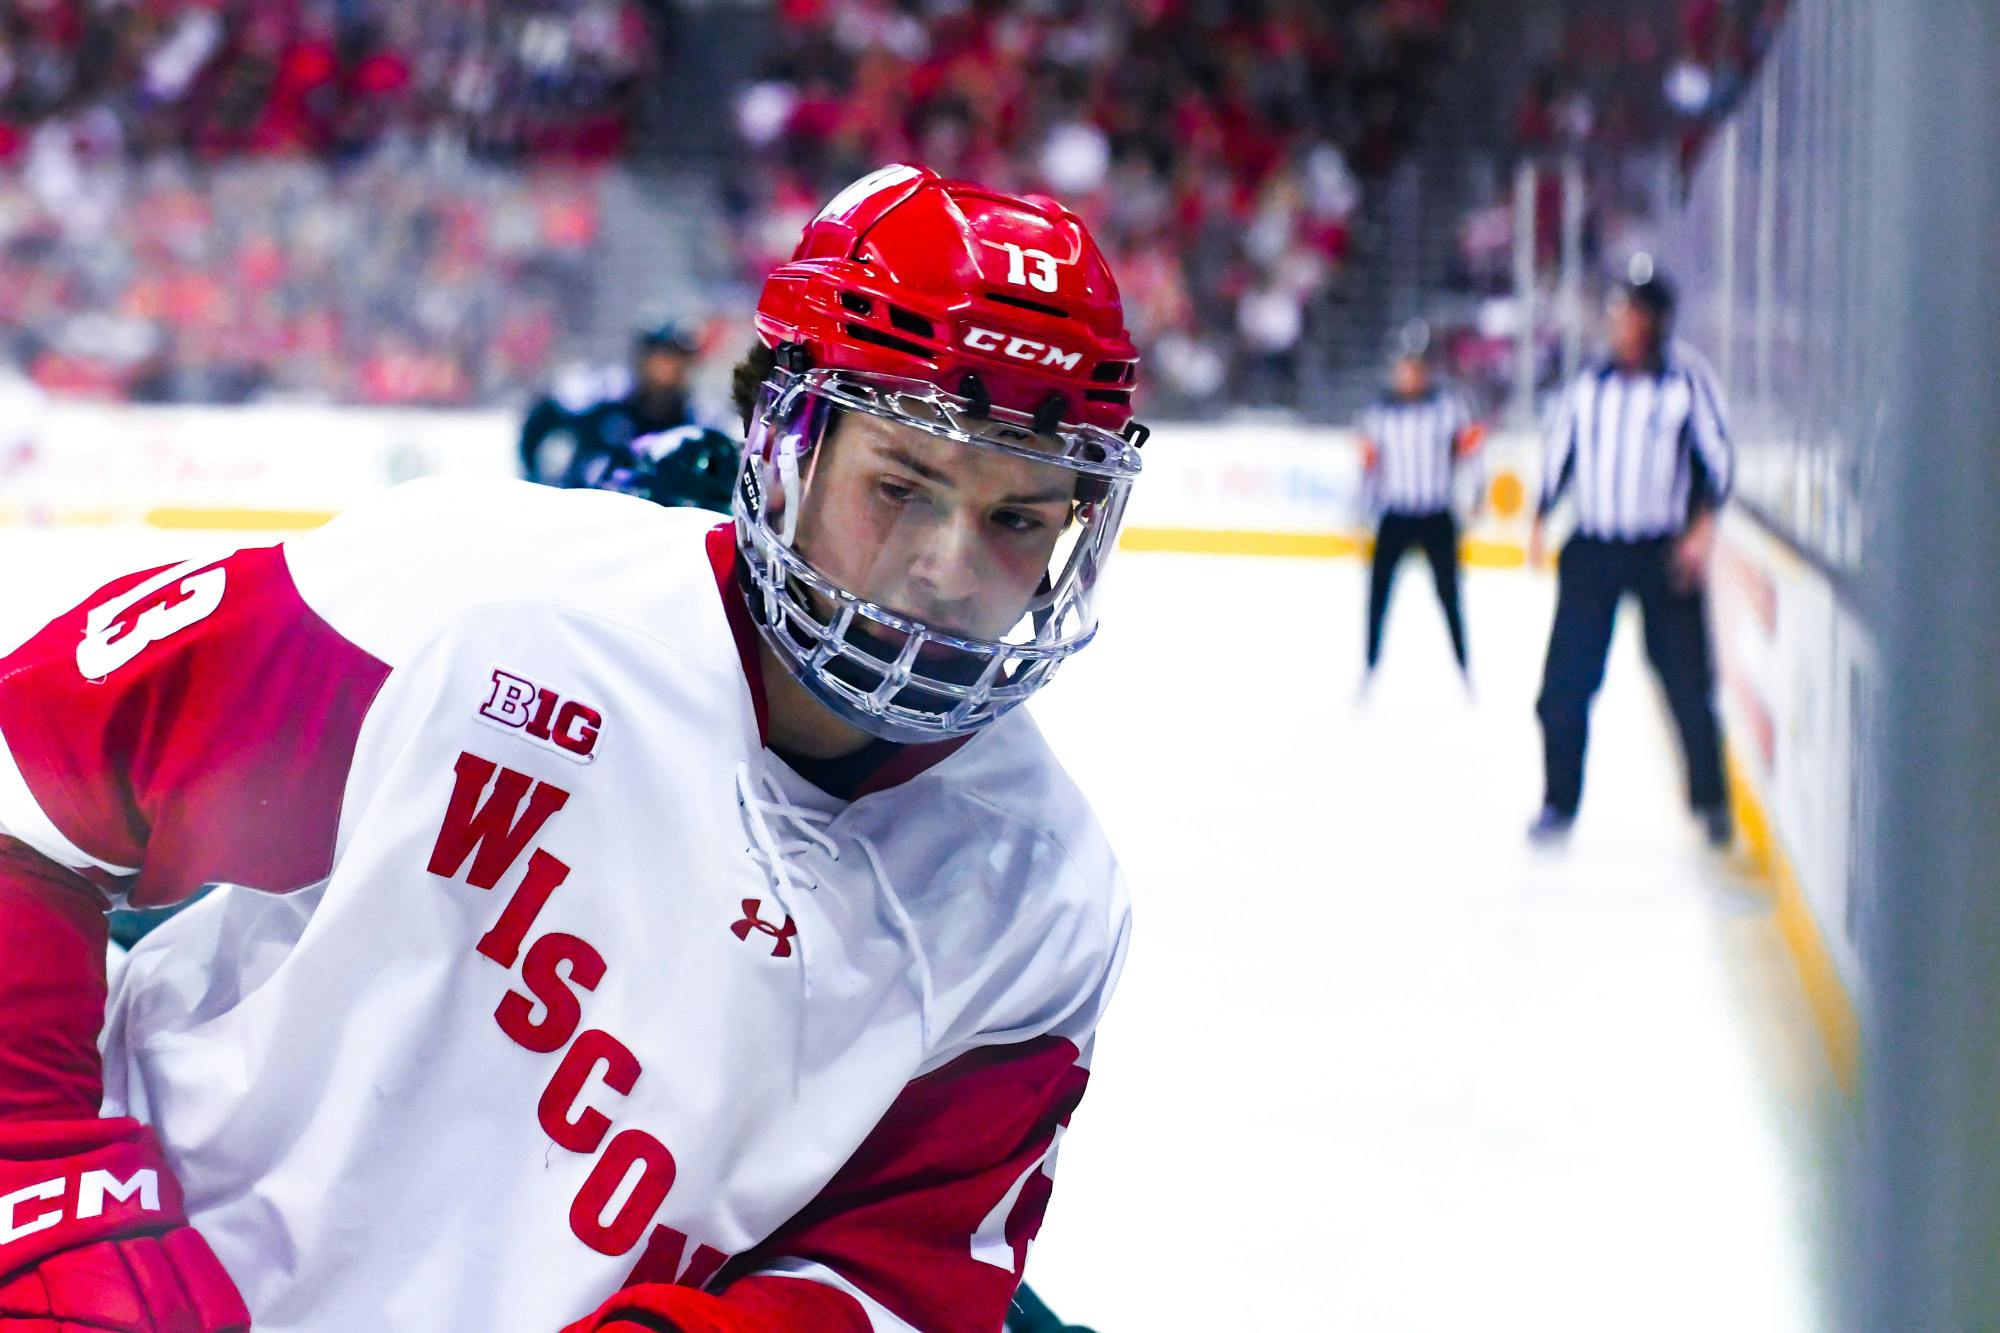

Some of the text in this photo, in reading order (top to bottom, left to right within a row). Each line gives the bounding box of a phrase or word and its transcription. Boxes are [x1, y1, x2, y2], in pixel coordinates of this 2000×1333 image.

[1003, 242, 1059, 293] 13
[962, 326, 1083, 371] CCM
[743, 471, 760, 511] CCM
